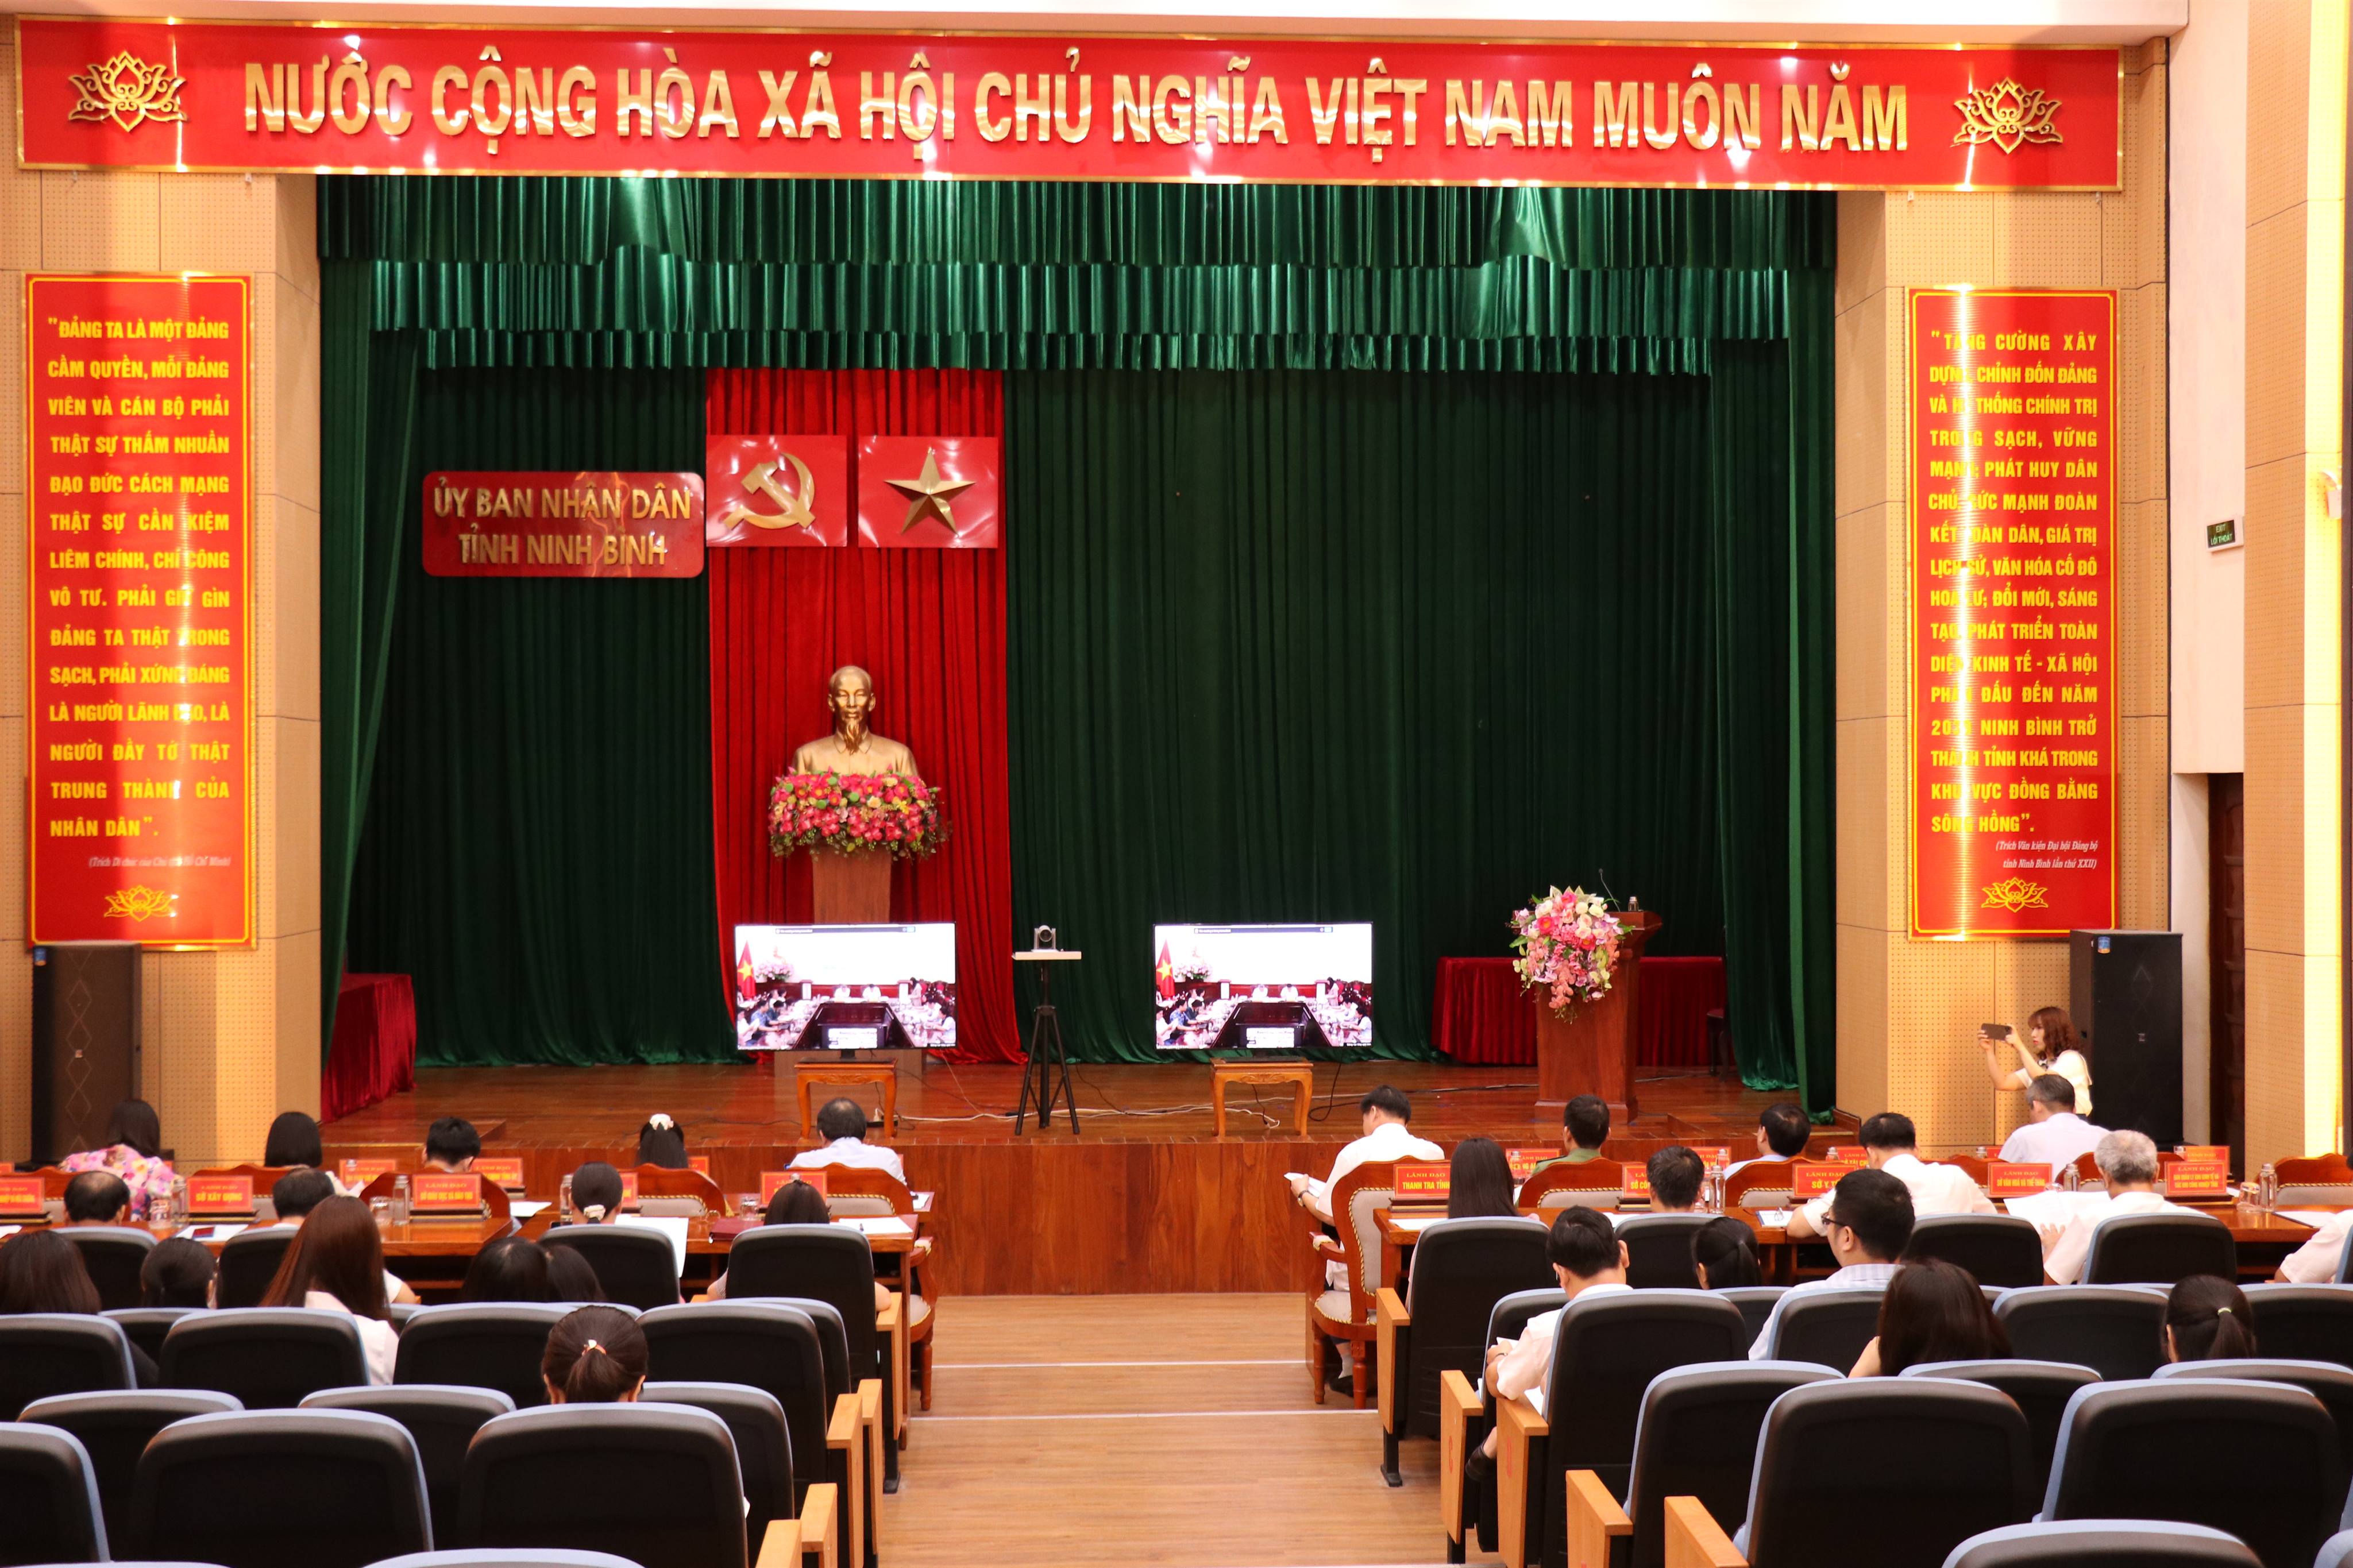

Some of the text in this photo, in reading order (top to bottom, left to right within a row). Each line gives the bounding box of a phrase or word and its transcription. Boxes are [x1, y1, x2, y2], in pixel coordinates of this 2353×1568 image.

[245, 45, 1908, 163] NƯỚC CỘNG HÒA XÃ HỘI CHỦ NGHĨA VIỆT NAM MUÔN NĂM
[106, 322, 124, 338] TA
[127, 319, 146, 338] LÀ
[149, 319, 183, 342] MỘT
[186, 316, 228, 338] ĐẢNG
[1996, 330, 2096, 350] CƯỜNG XÂY
[49, 355, 229, 379] CẦM QUYỀN, MỖI ĐẢNG
[1977, 361, 2096, 383] CHỈNH ĐỐN ĐẢNG
[48, 394, 229, 419] VIÊN VÀ CÁN BỘ PHẢI
[1930, 392, 2097, 417] VÀ THỐNG CHÍNH TRỊ
[51, 430, 229, 456] THẬT SỰ THẤM NHUẦN
[1995, 427, 2097, 449] SẠCH, VỮNG
[1985, 458, 2097, 477] PHÁT HUY DÂN
[51, 473, 229, 497] ĐẠO ĐỨC CÁCH MẠNG
[434, 476, 691, 519] ỦY BAN NHÂN DÂN
[2003, 494, 2048, 513] MẠNH
[2055, 492, 2096, 510] ĐOÀN
[51, 508, 229, 534] THẬT SỰ CẦN KIỆM
[2216, 524, 2226, 533] EXIT
[459, 523, 666, 565] TỈNH NINH BÌNH
[1931, 520, 2096, 546] KẾT DÂN, GIÁ TRỊ
[51, 549, 229, 570] LIÊM CHÍNH, CHÍ CÔNG
[1931, 554, 2097, 578] LỊCH SỬ, VĂN HÓA CỐ ĐÔ
[50, 584, 229, 607] VÔ TƯ. PHẢI GÌN
[1931, 590, 1959, 607] HOA
[1992, 582, 2017, 606] ĐỔI
[2022, 587, 2054, 608] MỚI,
[2058, 588, 2097, 607] SÁNG
[51, 625, 170, 648] ĐẢNG TA THẬT
[1968, 616, 2097, 639] PHÁT TRIỂN TOÀN
[51, 667, 95, 686] SẠCH,
[100, 662, 136, 683] PHẢI
[187, 663, 229, 683] ĐÁNG
[1973, 650, 2097, 675] KINH TẾ XÃ HỘI
[1981, 681, 2097, 702] ĐẤU ĐẾN NĂM
[50, 700, 229, 721] LÀ NGƯỜI LÃNH LÀ
[1981, 715, 2096, 735] NINH BÌNH TRỞ
[51, 739, 229, 763] NGƯỜI ĐẦY TỚ THẬT
[1984, 746, 2097, 766] TỈNH KHÁ TRONG
[52, 783, 106, 798] TRUNG
[196, 777, 229, 798] CỦA
[1972, 777, 2097, 802] VỰC ĐỒNG BẰNG
[51, 817, 97, 836] NHÂN
[1932, 813, 1974, 832] SÔNG
[2018, 859, 2034, 868] Ninh
[1402, 1181, 1422, 1189] THANH
[1424, 1181, 1435, 1189] TRA
